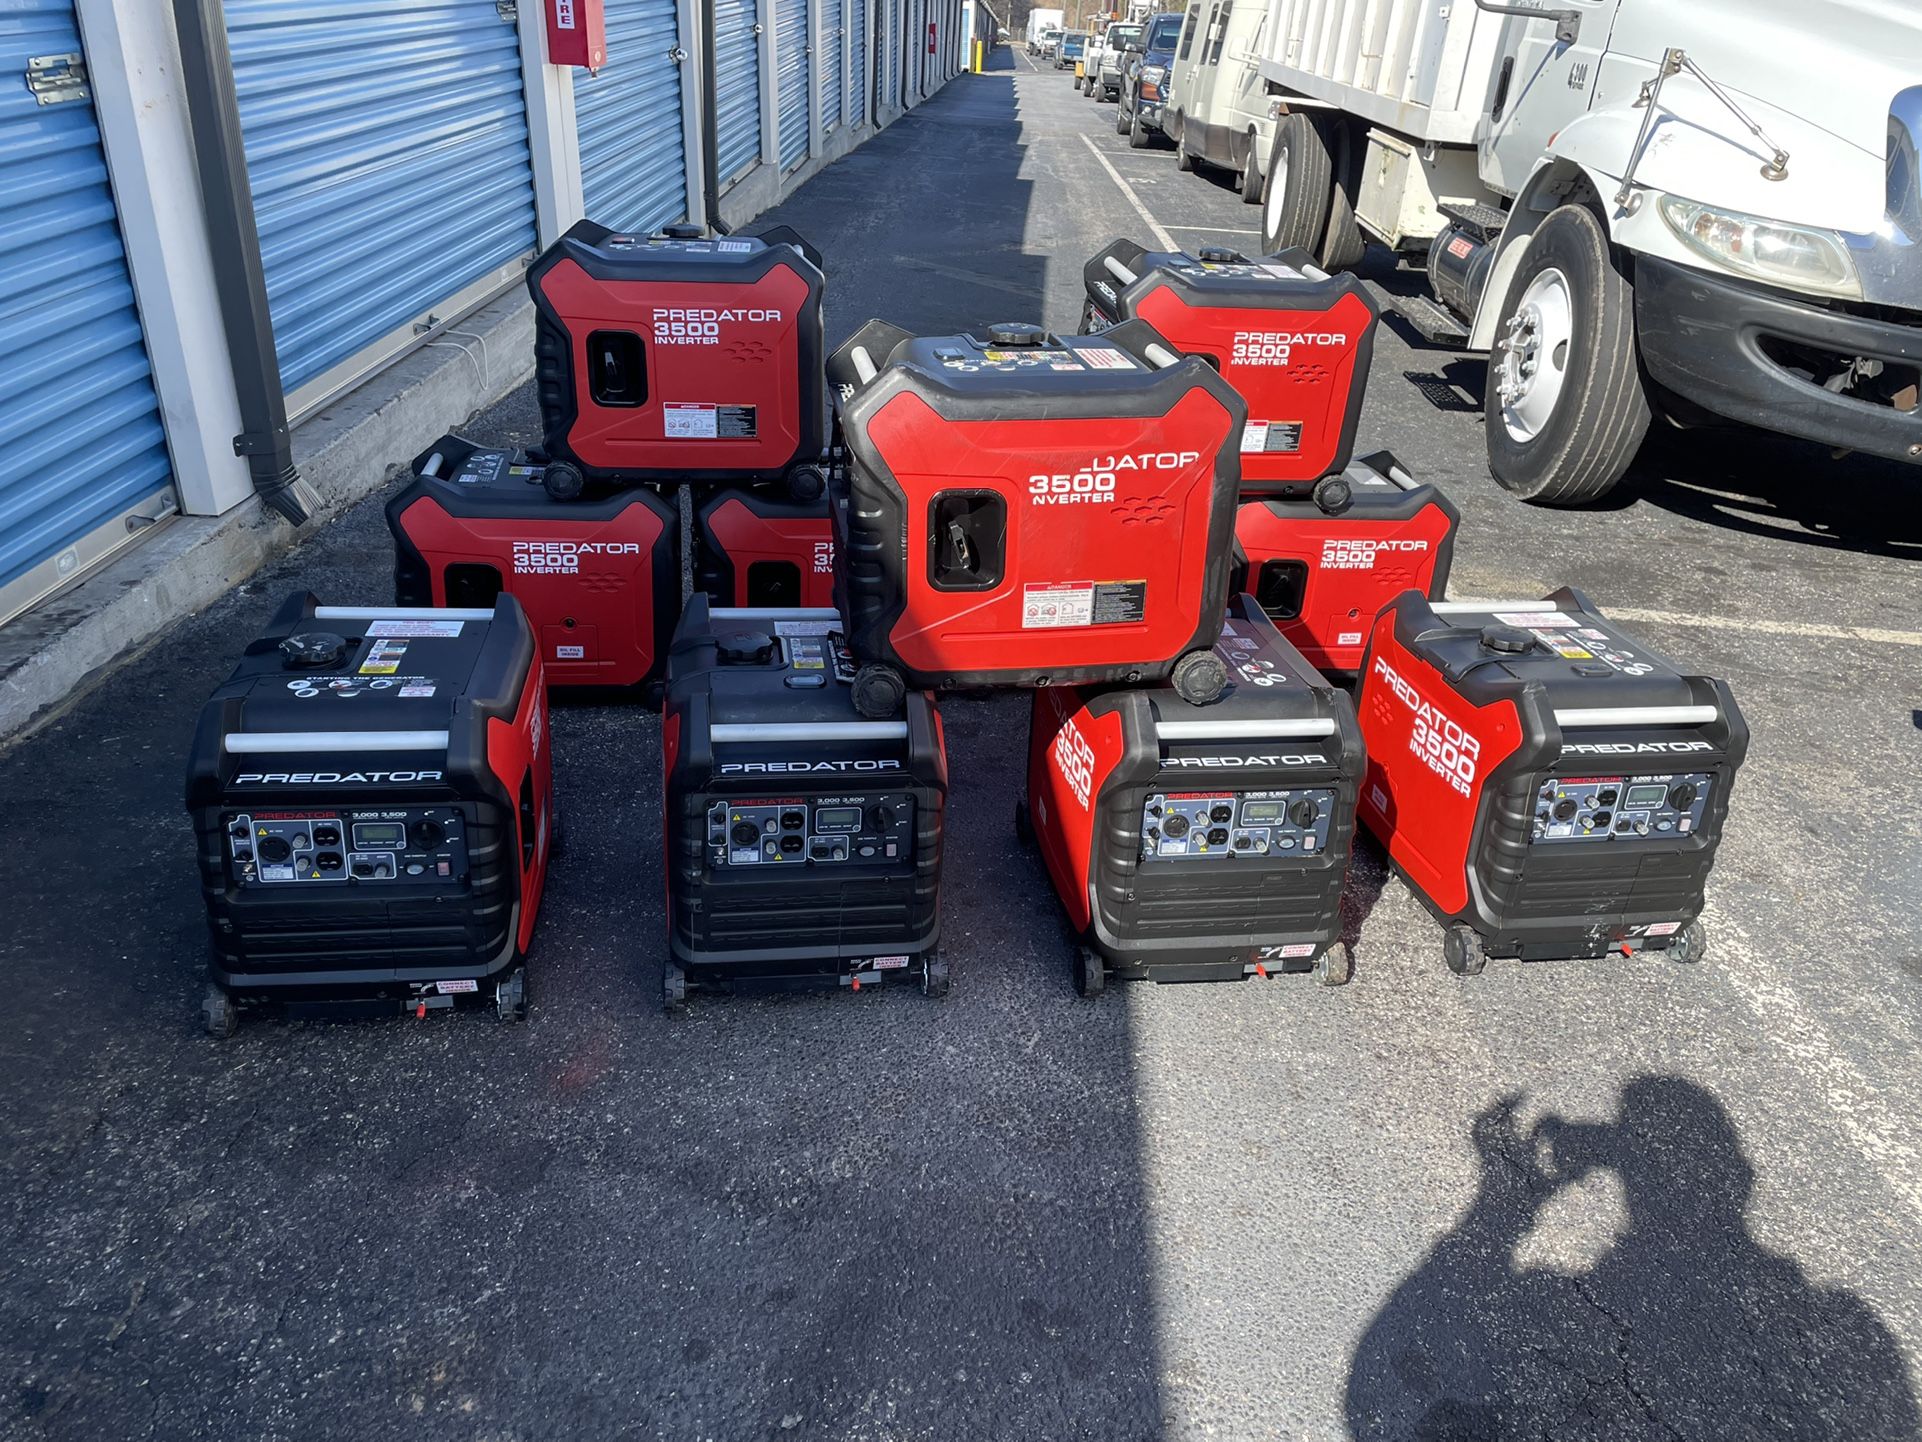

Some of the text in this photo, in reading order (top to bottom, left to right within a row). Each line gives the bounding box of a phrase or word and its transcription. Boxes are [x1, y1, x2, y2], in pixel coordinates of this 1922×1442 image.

[560, 0, 571, 24] RE
[653, 309, 781, 321] PREDATOR
[654, 322, 719, 336] 3500
[654, 337, 719, 345] INVERTER
[1234, 332, 1346, 345] PREDATOR
[1232, 344, 1290, 357] 3500
[1080, 452, 1200, 472] DATOR
[1028, 473, 1115, 494] 3500
[513, 542, 639, 554] PREDATOR
[1323, 540, 1428, 551] PREDATOR
[514, 554, 578, 566] 3500
[1322, 550, 1375, 562] 3500
[514, 566, 579, 574] INVERTER
[1320, 561, 1374, 569] INVERTER
[1375, 656, 1481, 761] PREDATOR
[1413, 717, 1476, 784] 3500
[1561, 742, 1713, 754] PREDATOR
[721, 760, 900, 773] PREDATOR
[1056, 729, 1092, 797] 3500
[1159, 755, 1327, 767] PREDATOR
[1409, 738, 1472, 799] INVERTER
[236, 771, 442, 784] PREDATOR
[1055, 748, 1089, 812] INVERTER
